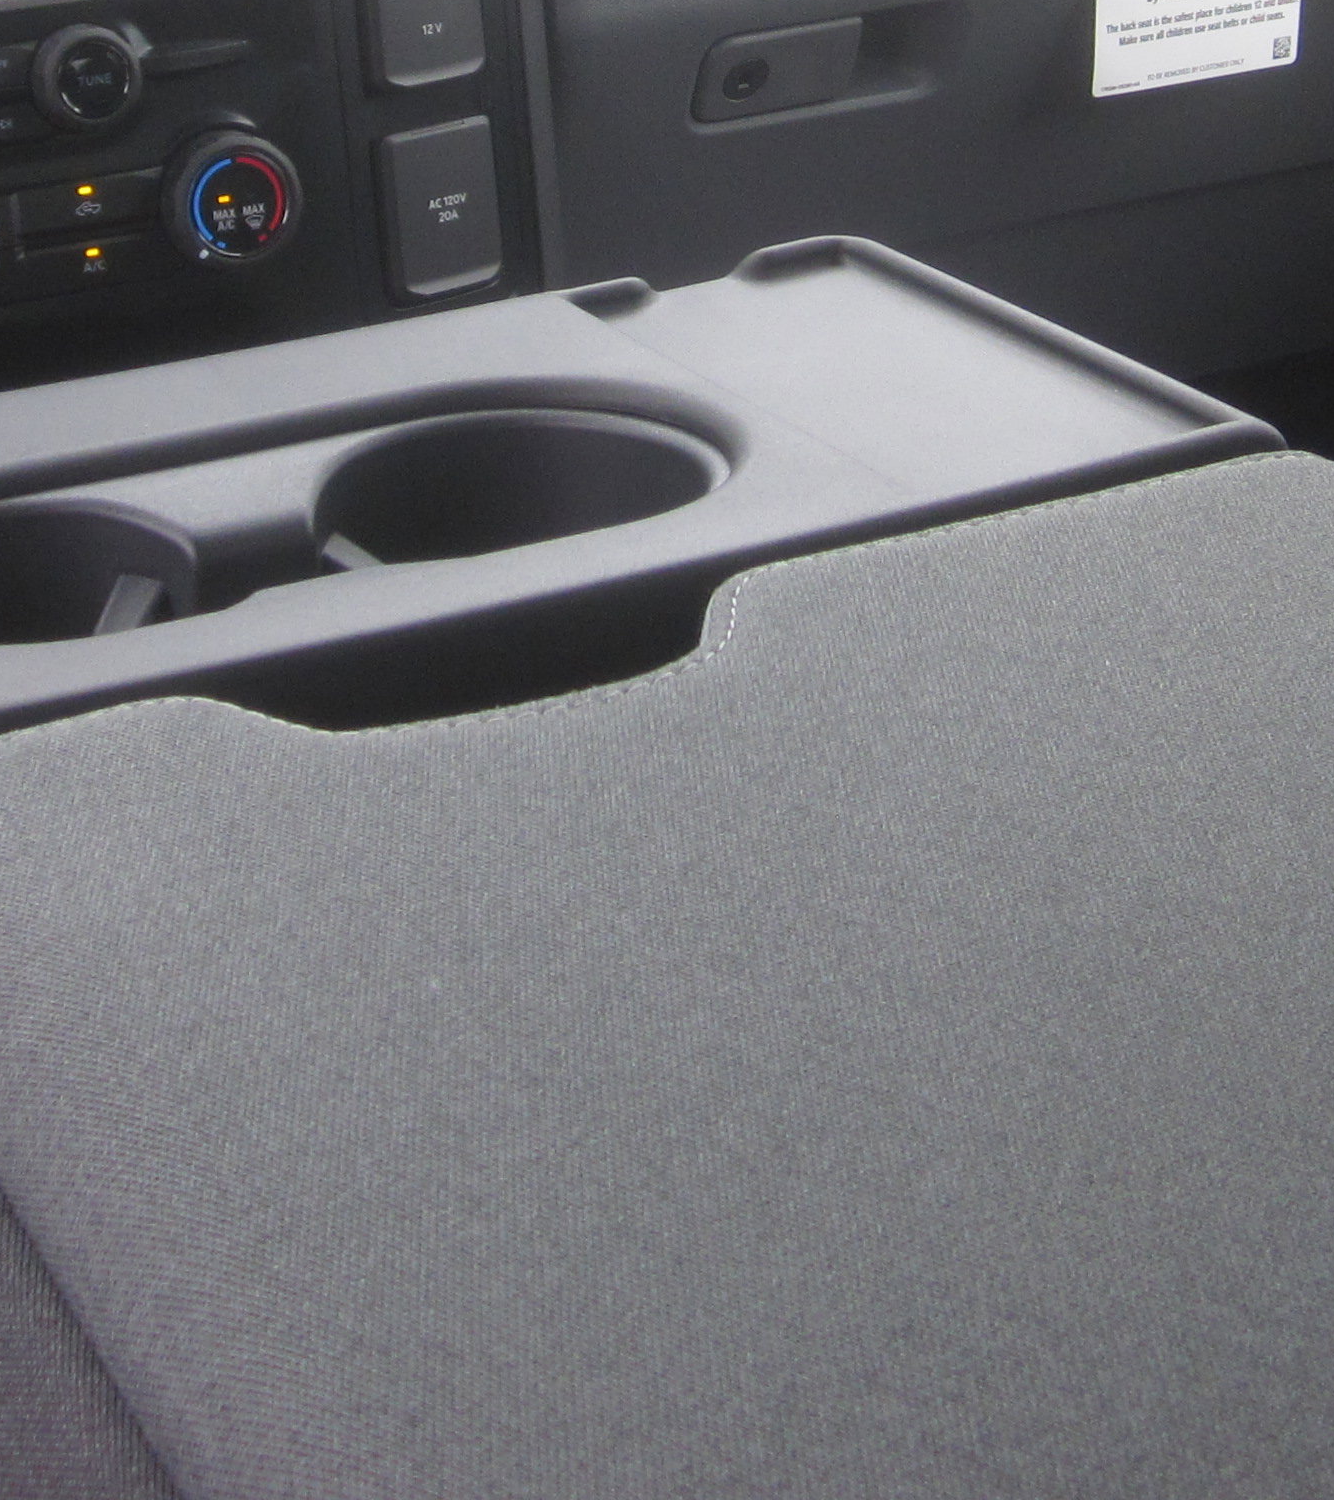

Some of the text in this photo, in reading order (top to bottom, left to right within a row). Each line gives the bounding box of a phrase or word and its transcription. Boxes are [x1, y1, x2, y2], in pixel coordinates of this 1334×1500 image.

[1106, 24, 1119, 34] The
[1120, 22, 1136, 32] back
[1138, 19, 1152, 29] seat
[1154, 17, 1160, 26] is
[1161, 15, 1172, 25] the
[1174, 12, 1194, 23] safest
[1195, 9, 1213, 21] place
[1214, 6, 1224, 15] for
[1225, 3, 1252, 14] children
[1254, 0, 1262, 9] 12
[1118, 36, 1138, 46] Make
[1139, 33, 1154, 42] sure
[1156, 30, 1164, 40] all
[1166, 27, 1193, 38] children
[1194, 25, 1206, 33] use
[1207, 22, 1221, 31] seat
[1223, 18, 1239, 29] belts
[1249, 14, 1265, 24] child
[1266, 11, 1285, 22] seats.
[77, 72, 112, 87] TUNE
[1164, 67, 1191, 78] REMOVED
[242, 202, 266, 216] MAX
[428, 193, 467, 211] AC 120V
[213, 208, 236, 221] MAX
[438, 210, 459, 224] 20A
[217, 219, 236, 232] A/C
[82, 259, 107, 274] A/C
